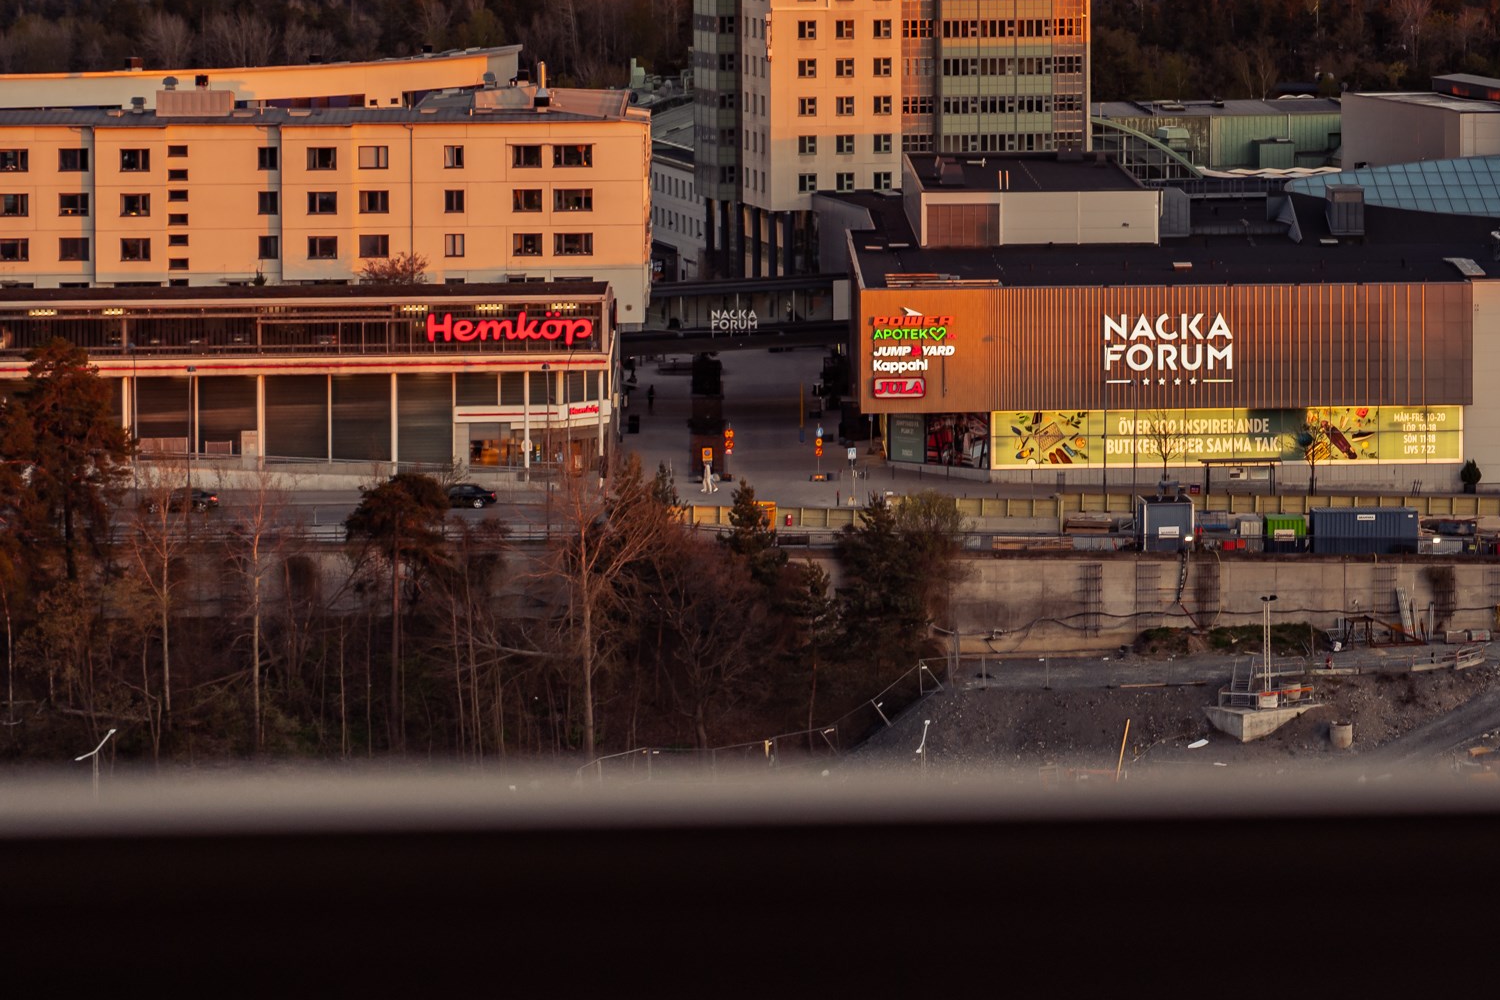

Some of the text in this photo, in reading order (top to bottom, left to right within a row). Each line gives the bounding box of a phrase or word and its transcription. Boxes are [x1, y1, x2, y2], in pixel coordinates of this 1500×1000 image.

[711, 309, 757, 319] NACKA
[711, 320, 757, 330] FORUM
[873, 315, 955, 326] POWER
[427, 311, 592, 346] Hemköp
[1104, 312, 1233, 341] NACKA
[873, 329, 928, 340] APOTEK
[1104, 342, 1233, 371] FORUM
[873, 359, 928, 374] Kappahl
[875, 381, 923, 394] JULA
[1393, 411, 1446, 422] MÅN-FRE 10-20
[1118, 416, 1150, 435] ÖVER
[1180, 418, 1270, 434] INSPIRERANDE
[1402, 422, 1437, 431] LÖR 10-18
[1403, 433, 1417, 443] SÖN
[1106, 437, 1283, 455] BUTIKER UNDER SAMMA TAK.
[1404, 445, 1419, 454] LIVS
